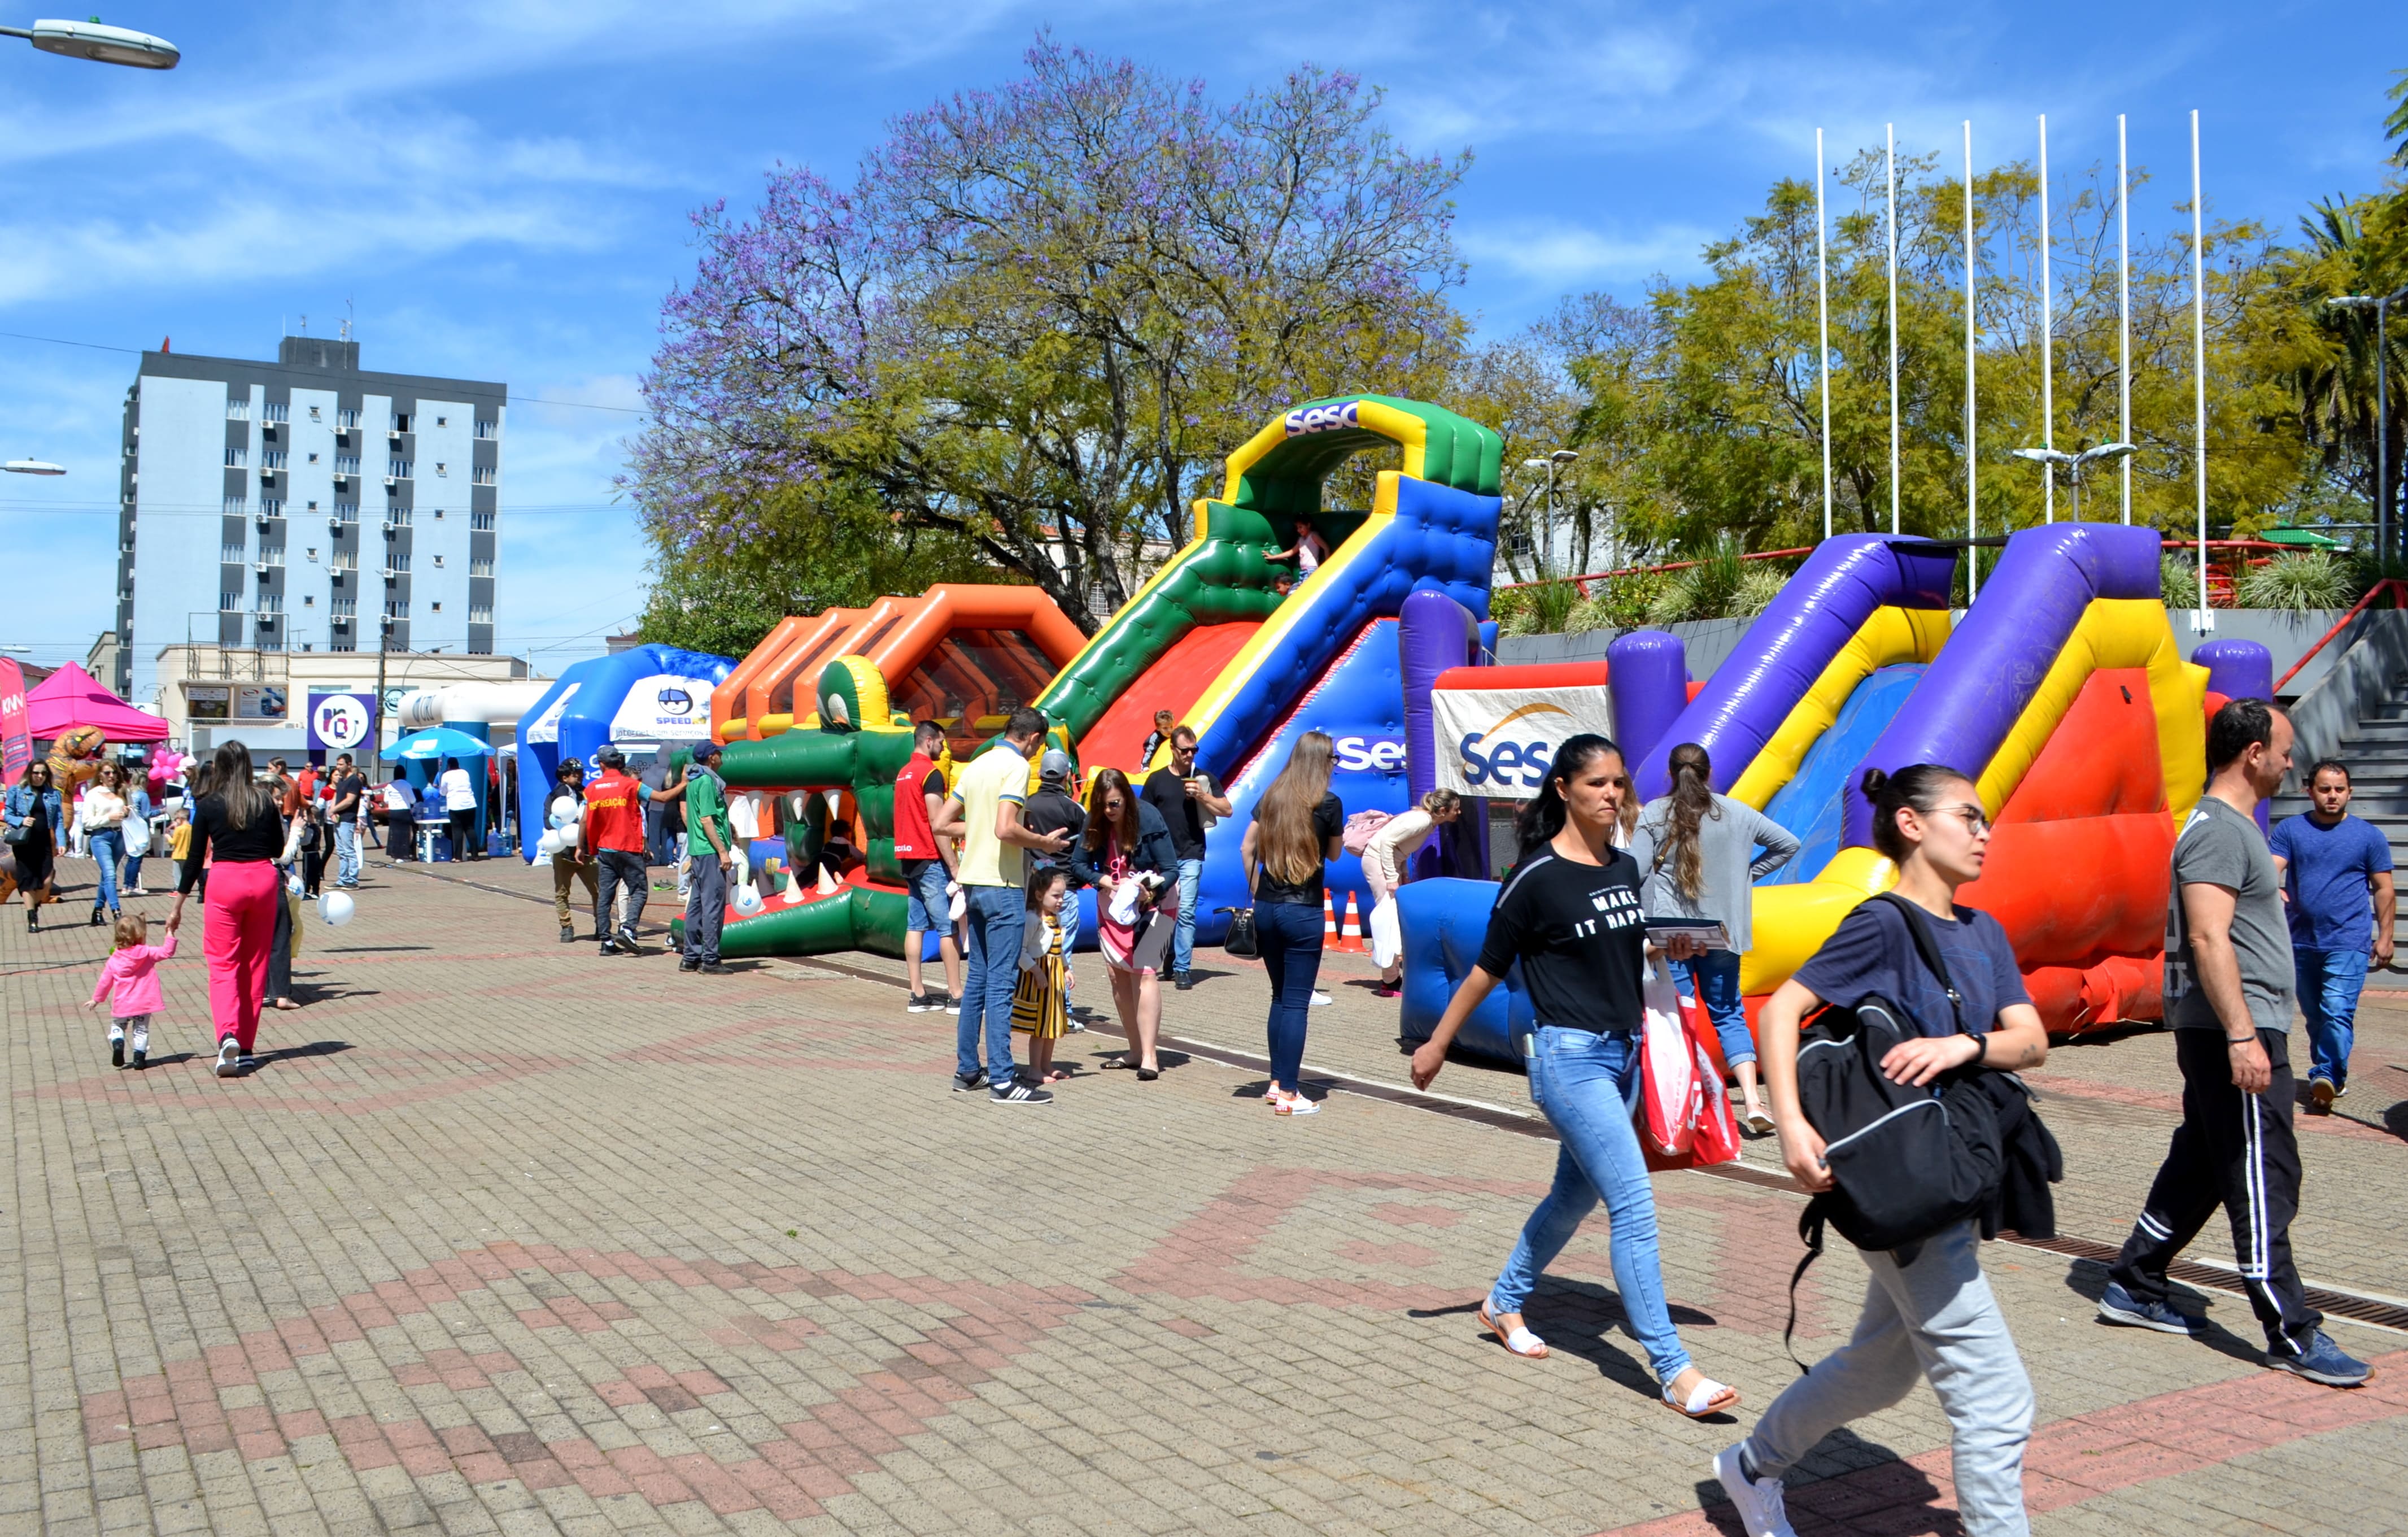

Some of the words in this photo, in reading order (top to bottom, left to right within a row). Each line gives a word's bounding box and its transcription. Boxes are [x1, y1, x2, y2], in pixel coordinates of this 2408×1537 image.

[1337, 737, 1407, 770] Se
[1460, 732, 1561, 787] Ses
[588, 795, 627, 811] RECREAÇÃO
[1592, 891, 1638, 911] MAKE
[1574, 919, 1596, 938] IT
